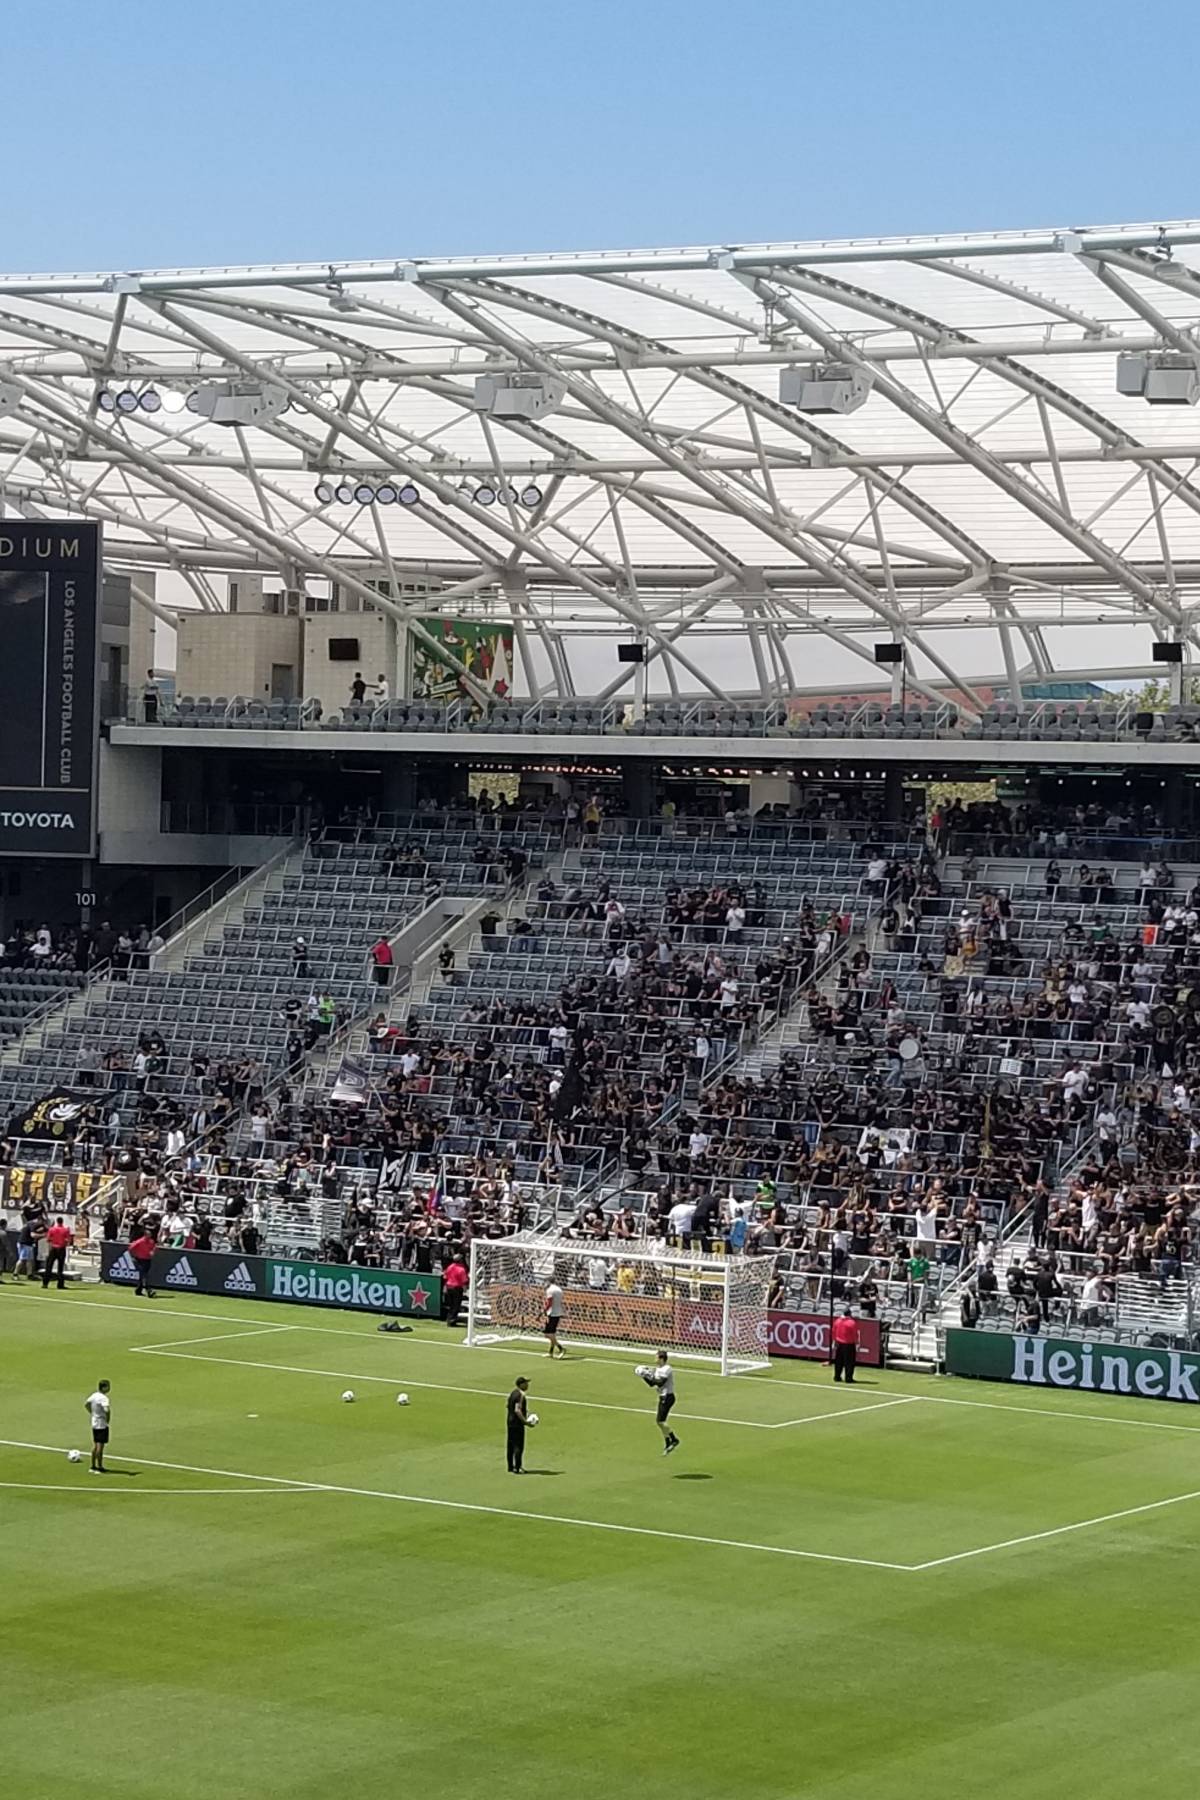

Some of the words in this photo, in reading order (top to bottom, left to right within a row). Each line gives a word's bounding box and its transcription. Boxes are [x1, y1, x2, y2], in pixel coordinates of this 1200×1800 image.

[0, 537, 79, 558] DIUM
[64, 580, 76, 607] LOS
[63, 608, 74, 671] ANGELES
[61, 673, 73, 745] FOOTBALL
[60, 748, 72, 784] CLUB
[0, 812, 75, 829] TOYOTA
[75, 892, 97, 907] 101
[109, 1267, 140, 1281] adidas
[165, 1273, 198, 1287] adidas
[224, 1279, 256, 1292] adidas
[271, 1264, 403, 1309] Heineken
